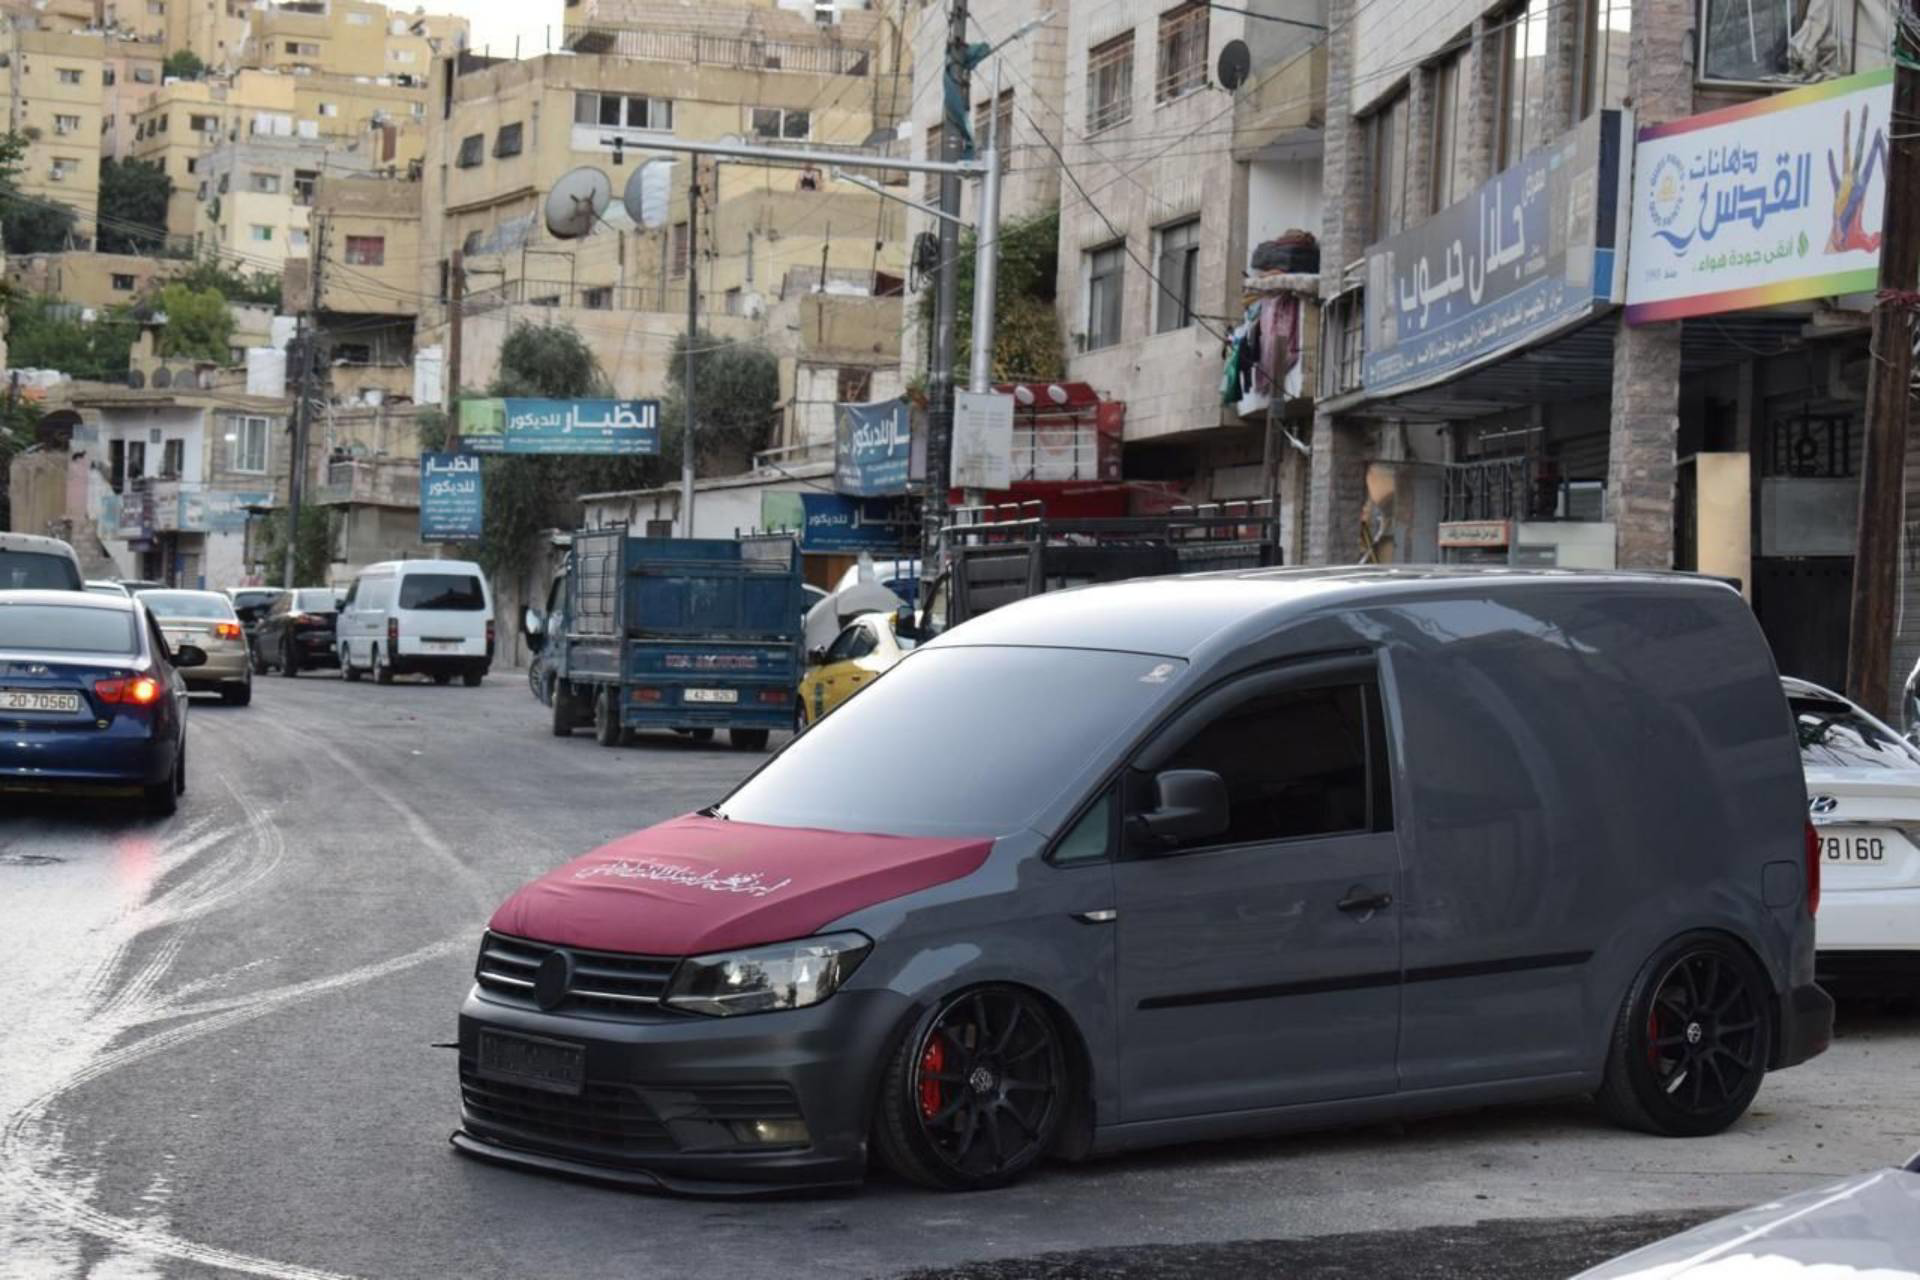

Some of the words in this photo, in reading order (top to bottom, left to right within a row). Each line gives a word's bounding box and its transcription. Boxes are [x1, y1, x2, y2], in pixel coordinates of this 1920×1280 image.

[1689, 142, 1758, 180] دهانات
[1698, 151, 1812, 241] القدس
[1469, 181, 1525, 305] جلال
[509, 412, 560, 430] للديكور
[427, 479, 476, 497] للديكور
[808, 513, 848, 527] للديكور
